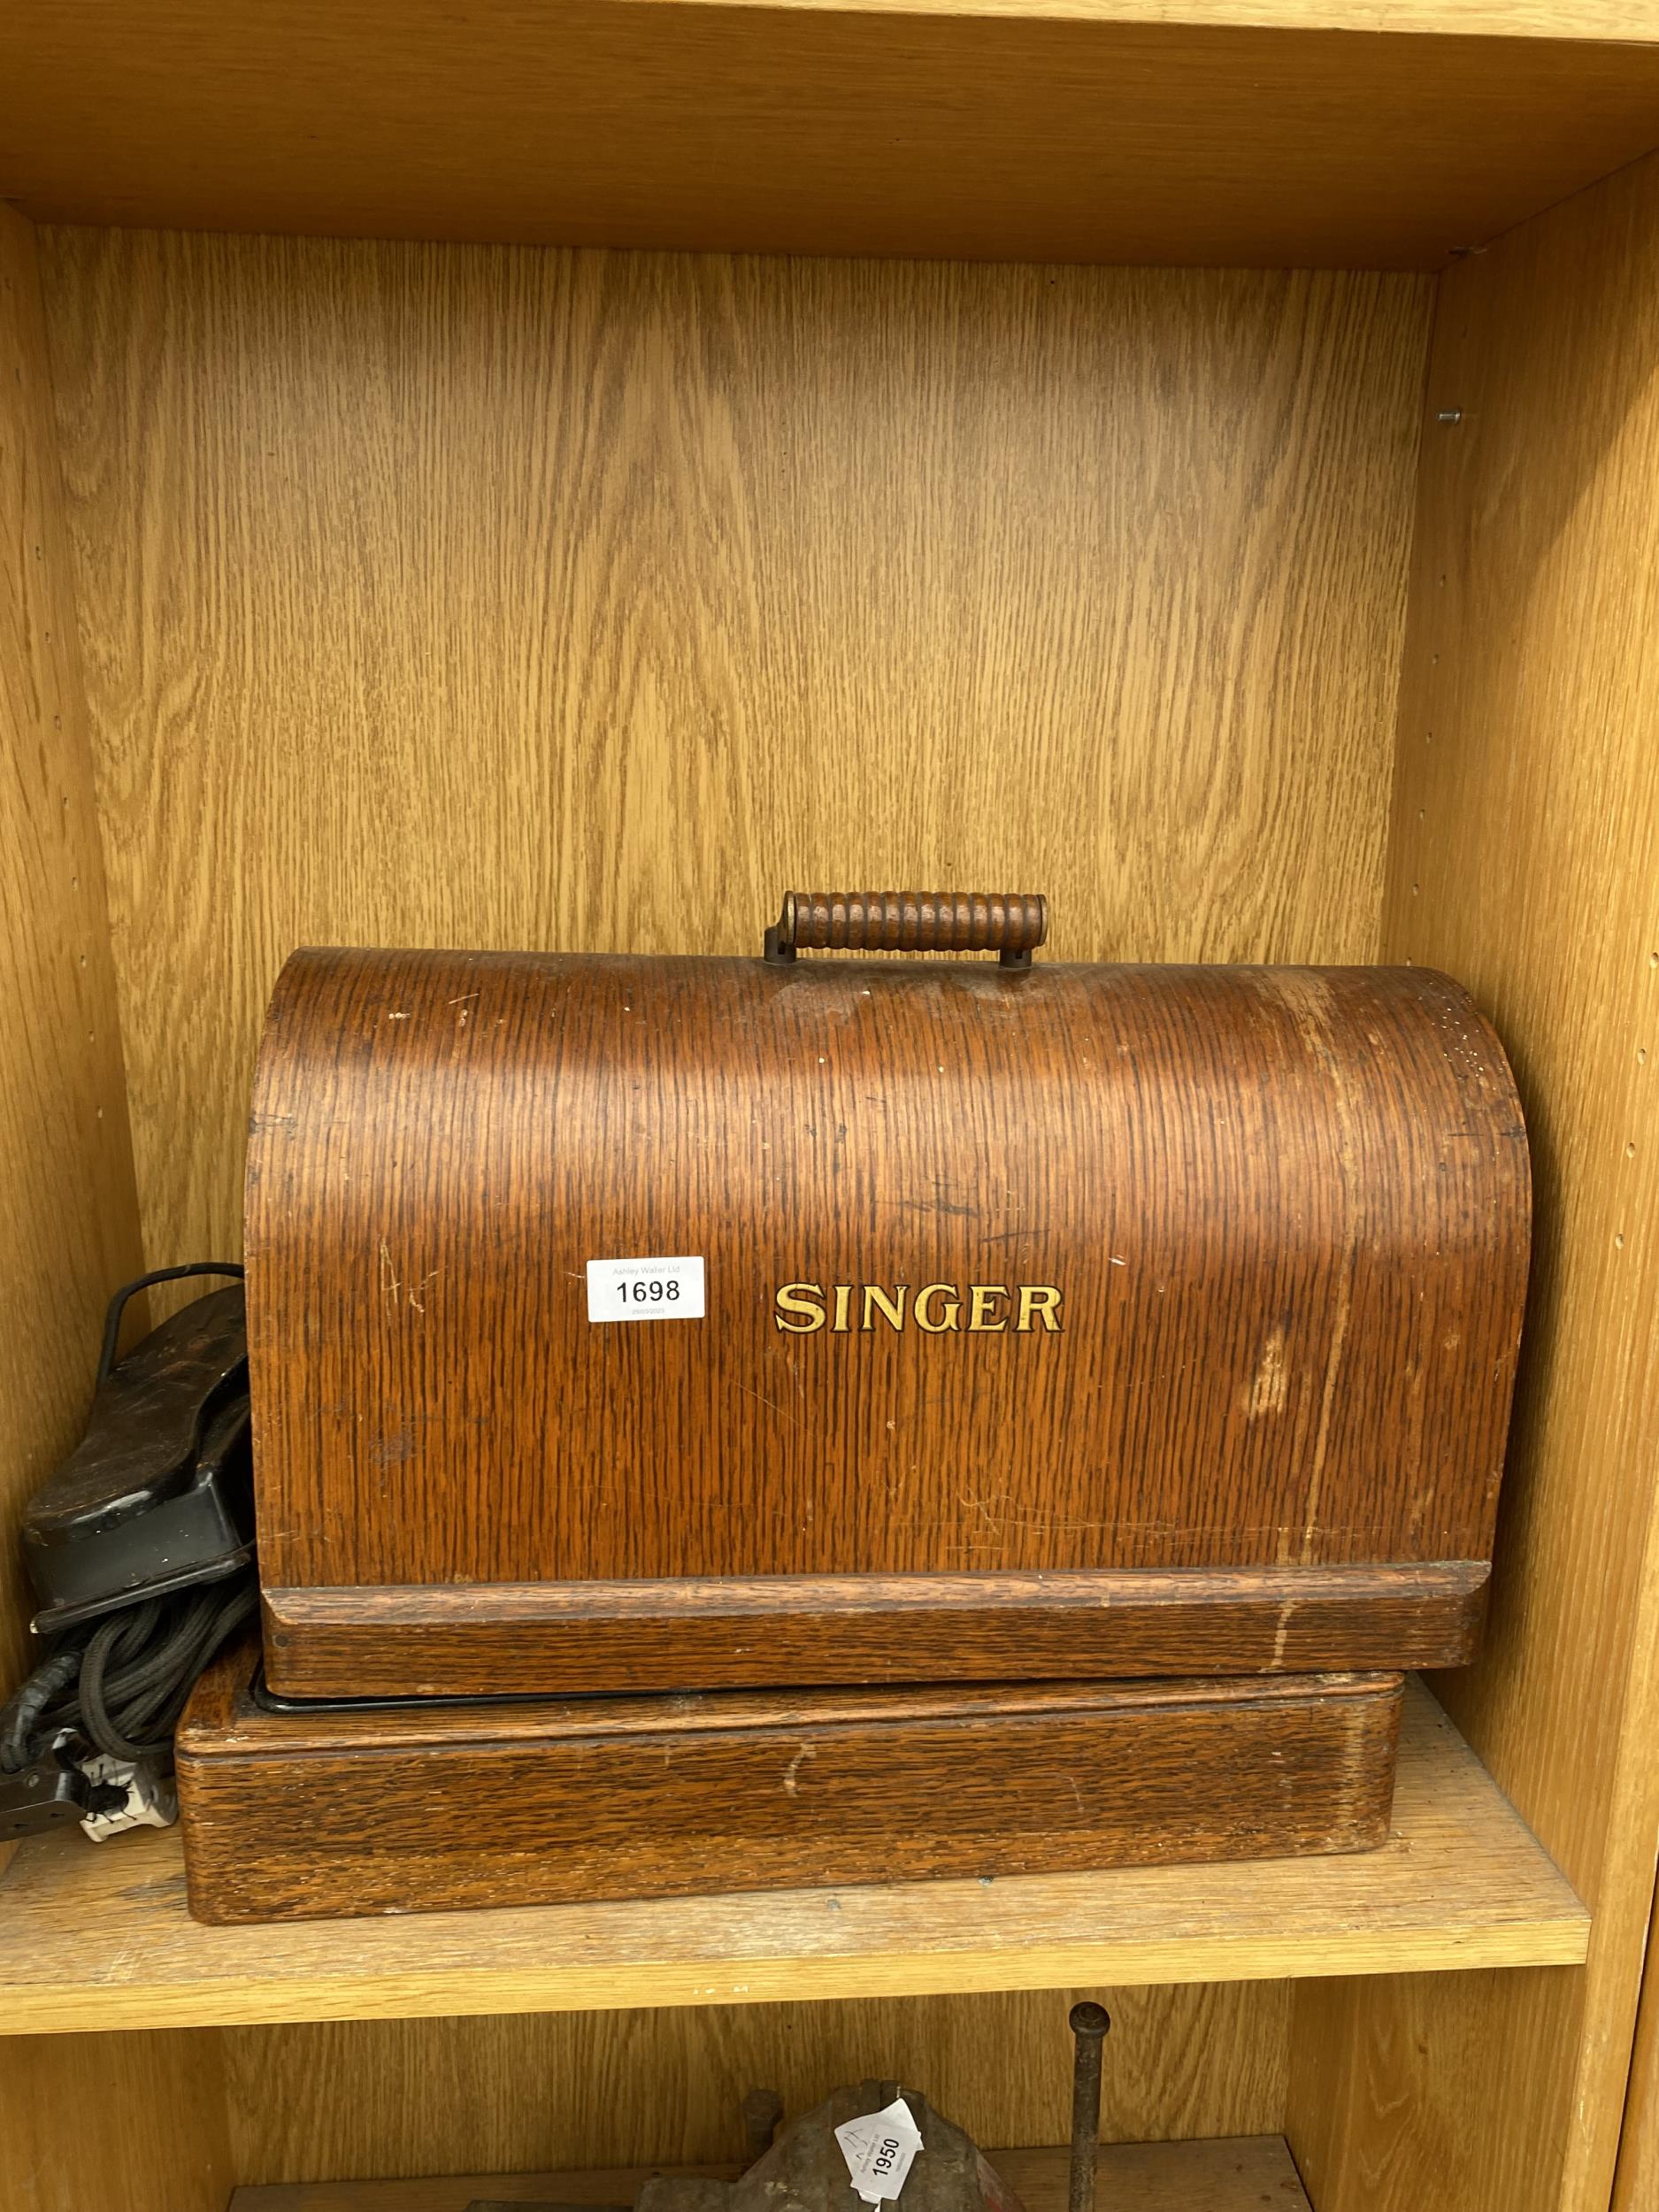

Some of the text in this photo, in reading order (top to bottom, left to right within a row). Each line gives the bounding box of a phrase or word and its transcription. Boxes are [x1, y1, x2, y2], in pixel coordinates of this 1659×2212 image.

[612, 1266, 639, 1276] Ashley
[617, 1280, 680, 1302] 1698
[774, 1282, 1065, 1334] SINGER
[872, 2139, 899, 2176] 1950
